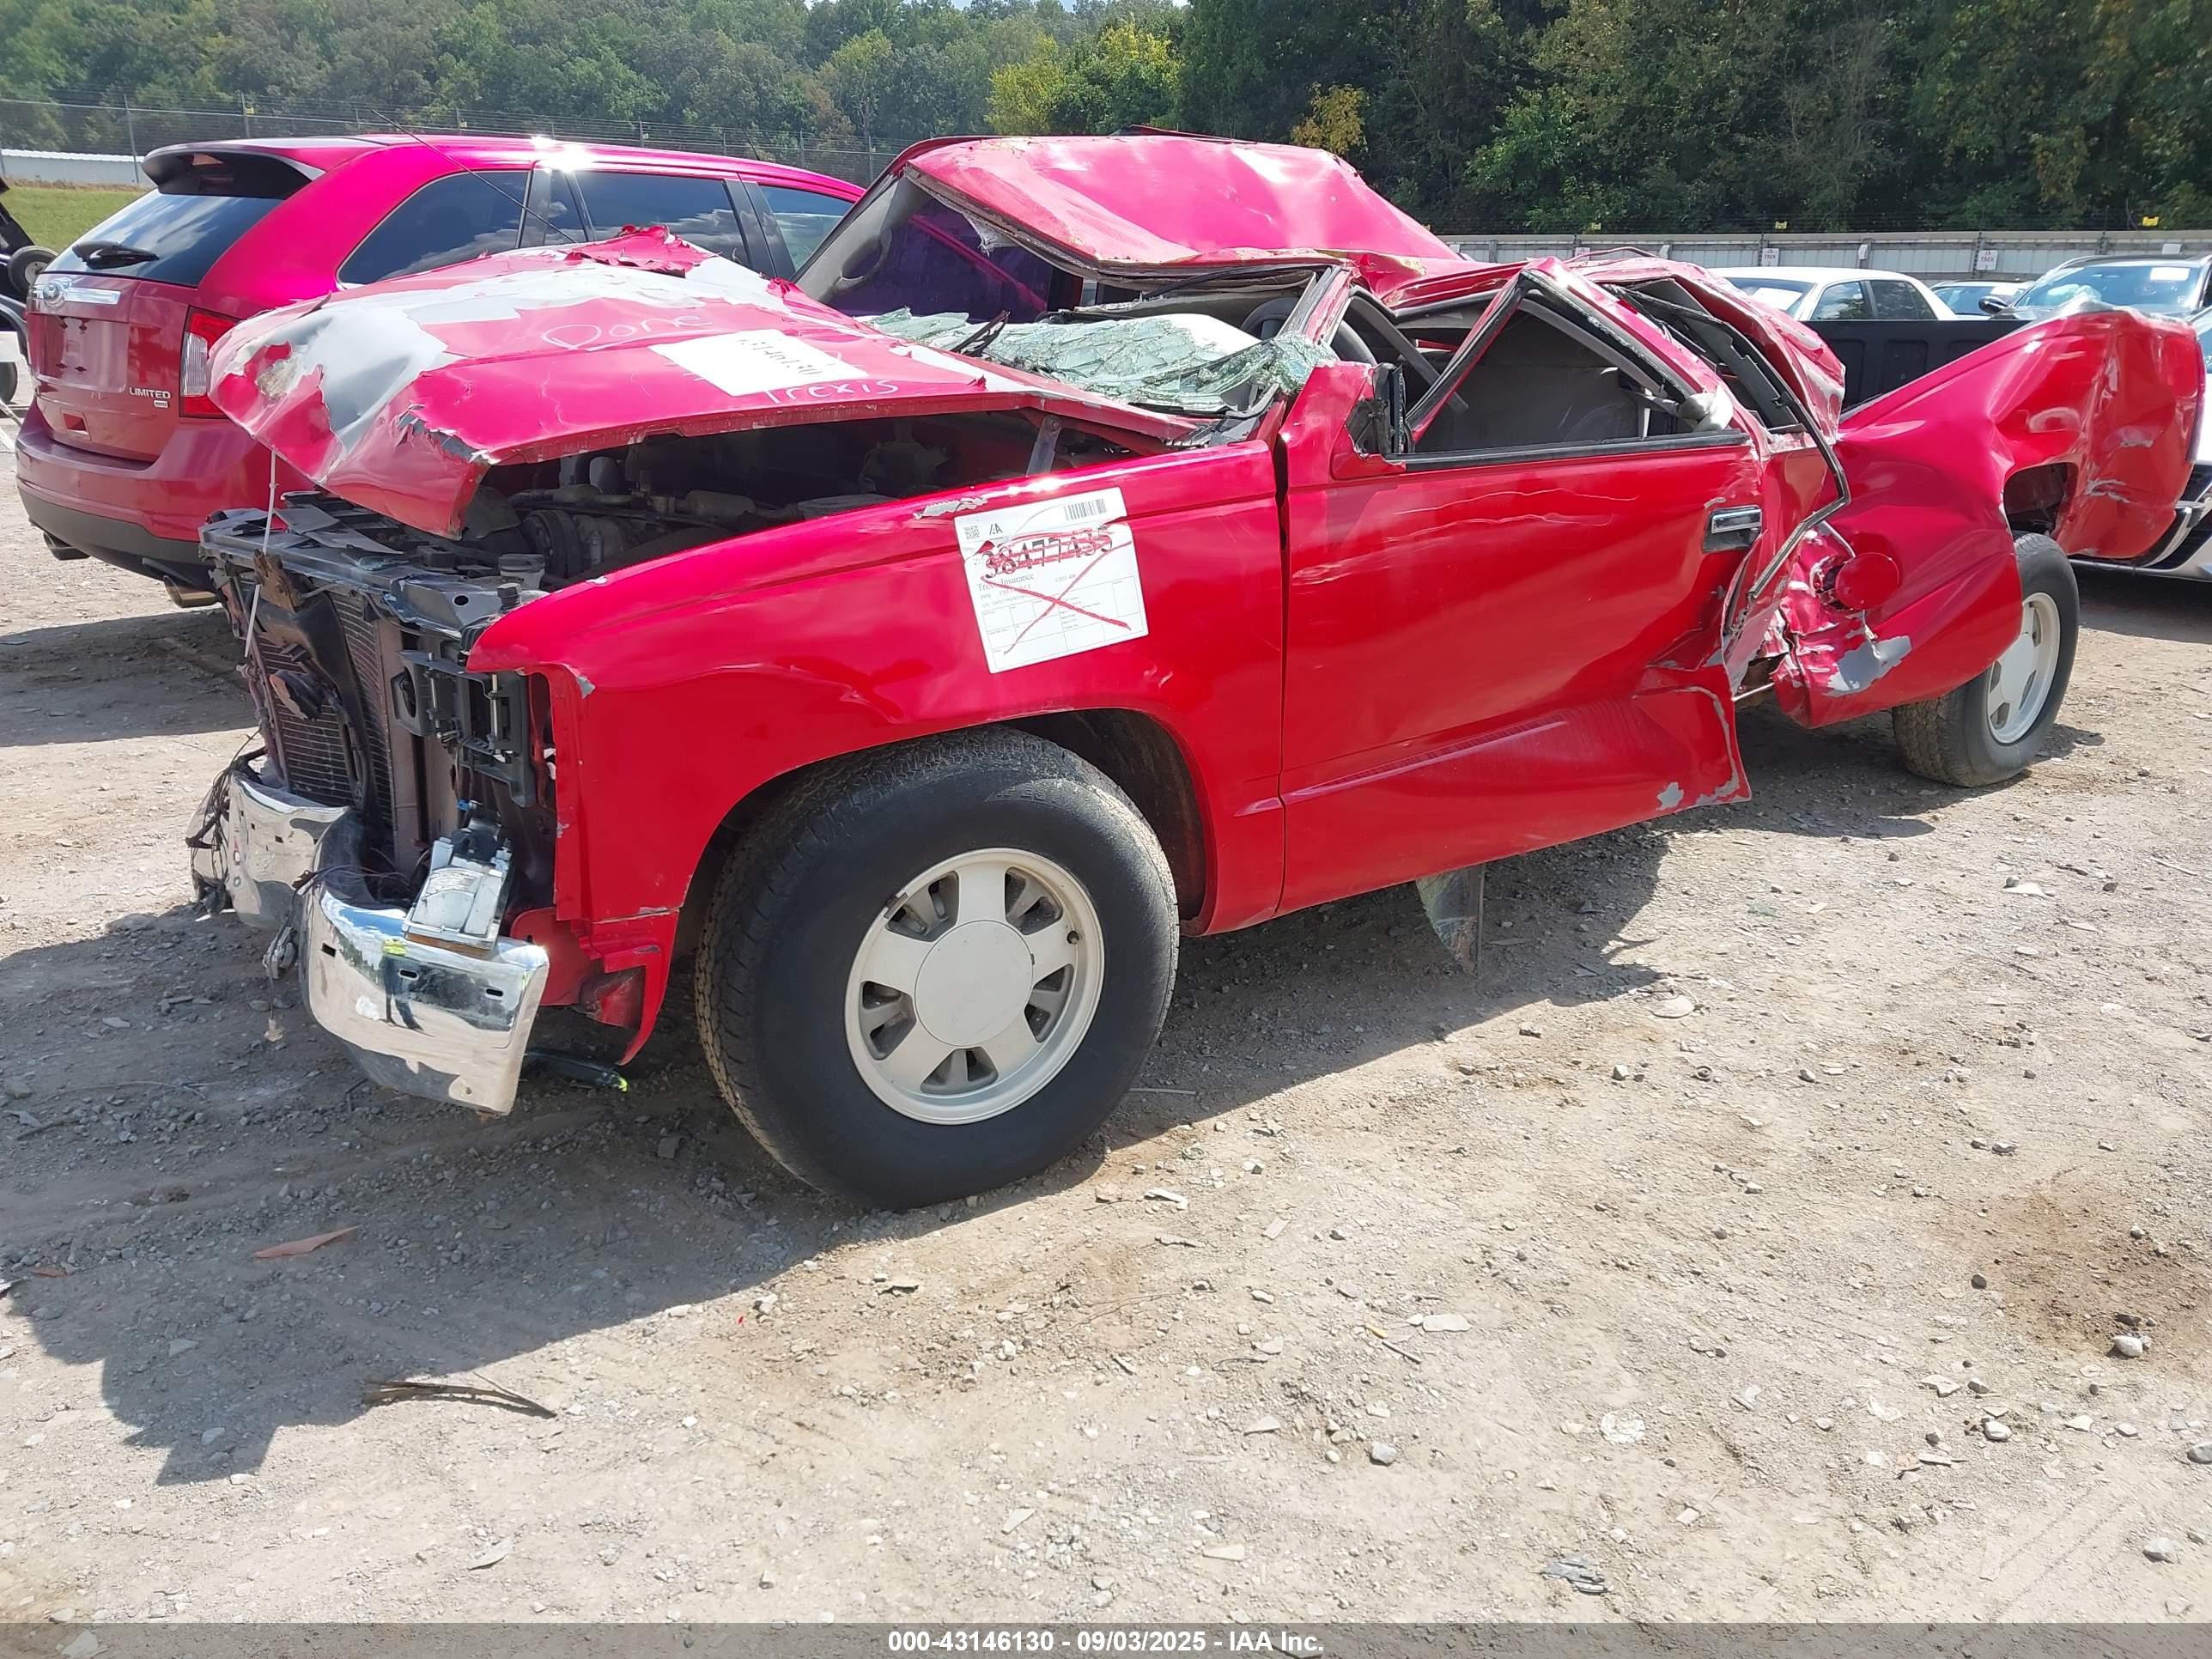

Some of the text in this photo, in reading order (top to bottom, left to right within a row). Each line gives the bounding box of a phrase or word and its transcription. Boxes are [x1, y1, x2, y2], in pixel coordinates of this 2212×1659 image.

[541, 315, 714, 350] Done
[129, 386, 172, 399] LIMITED
[760, 379, 900, 404] Trexis
